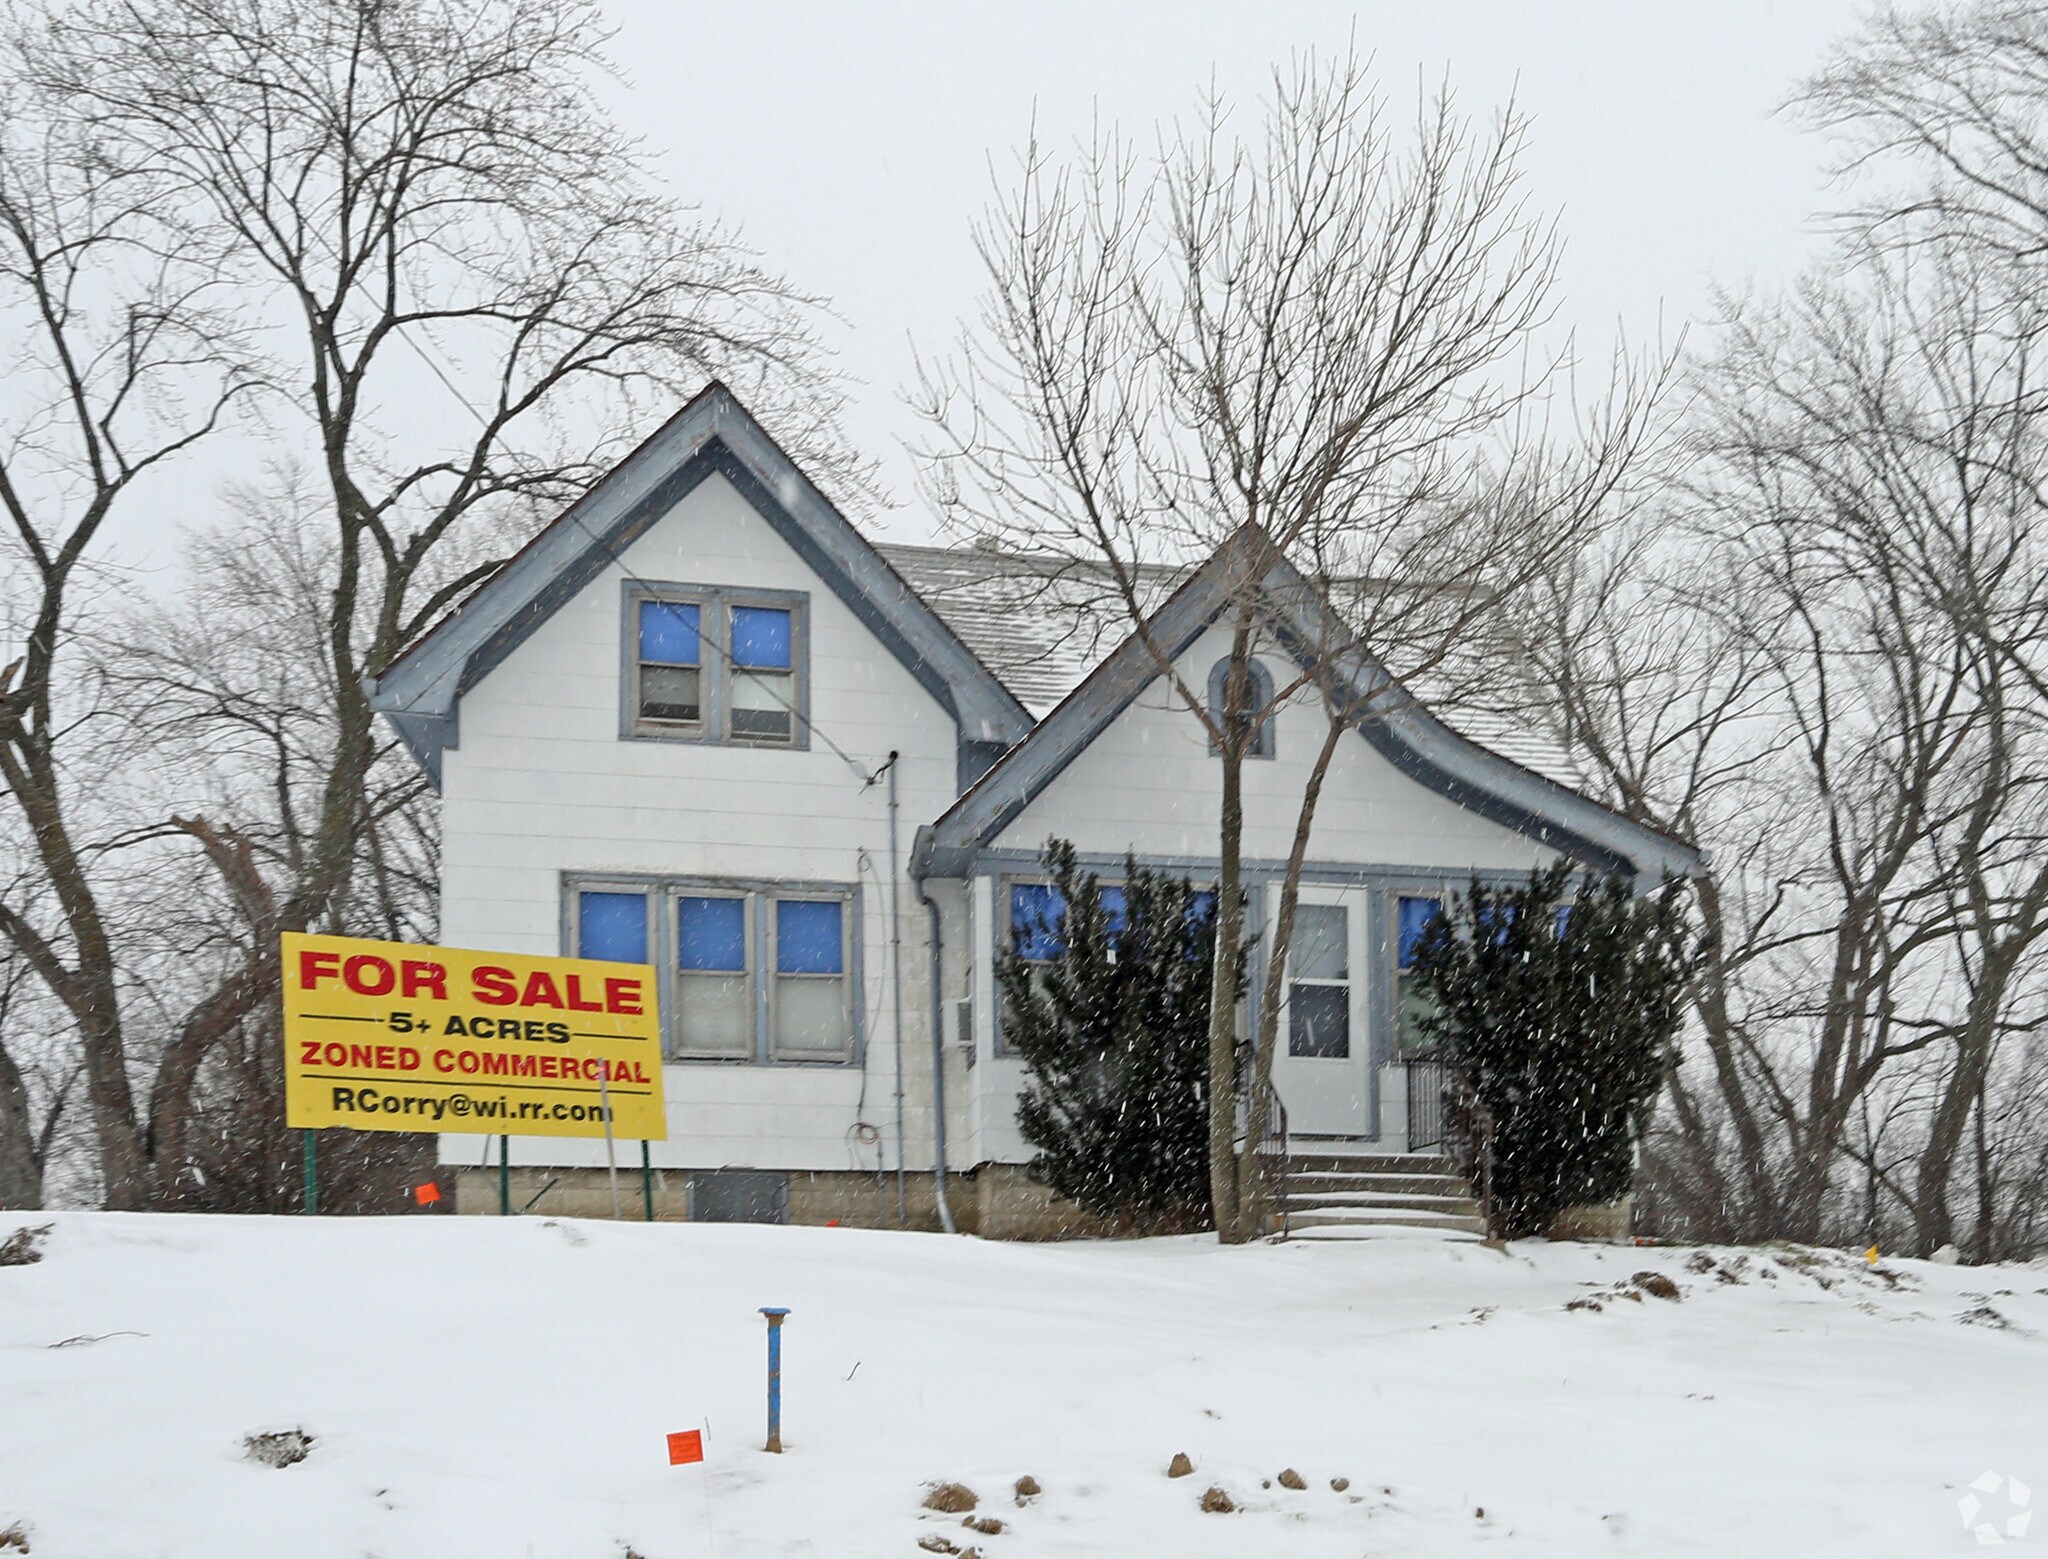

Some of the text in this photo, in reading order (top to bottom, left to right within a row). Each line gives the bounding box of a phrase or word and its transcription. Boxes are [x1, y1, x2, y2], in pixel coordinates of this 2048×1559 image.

[299, 951, 644, 1015] FOR SALE
[388, 1012, 571, 1044] 5+ ACRES
[300, 1041, 651, 1084] ZONED COMMERCIAL
[332, 1087, 614, 1122] RCorry@wi.rr.com
